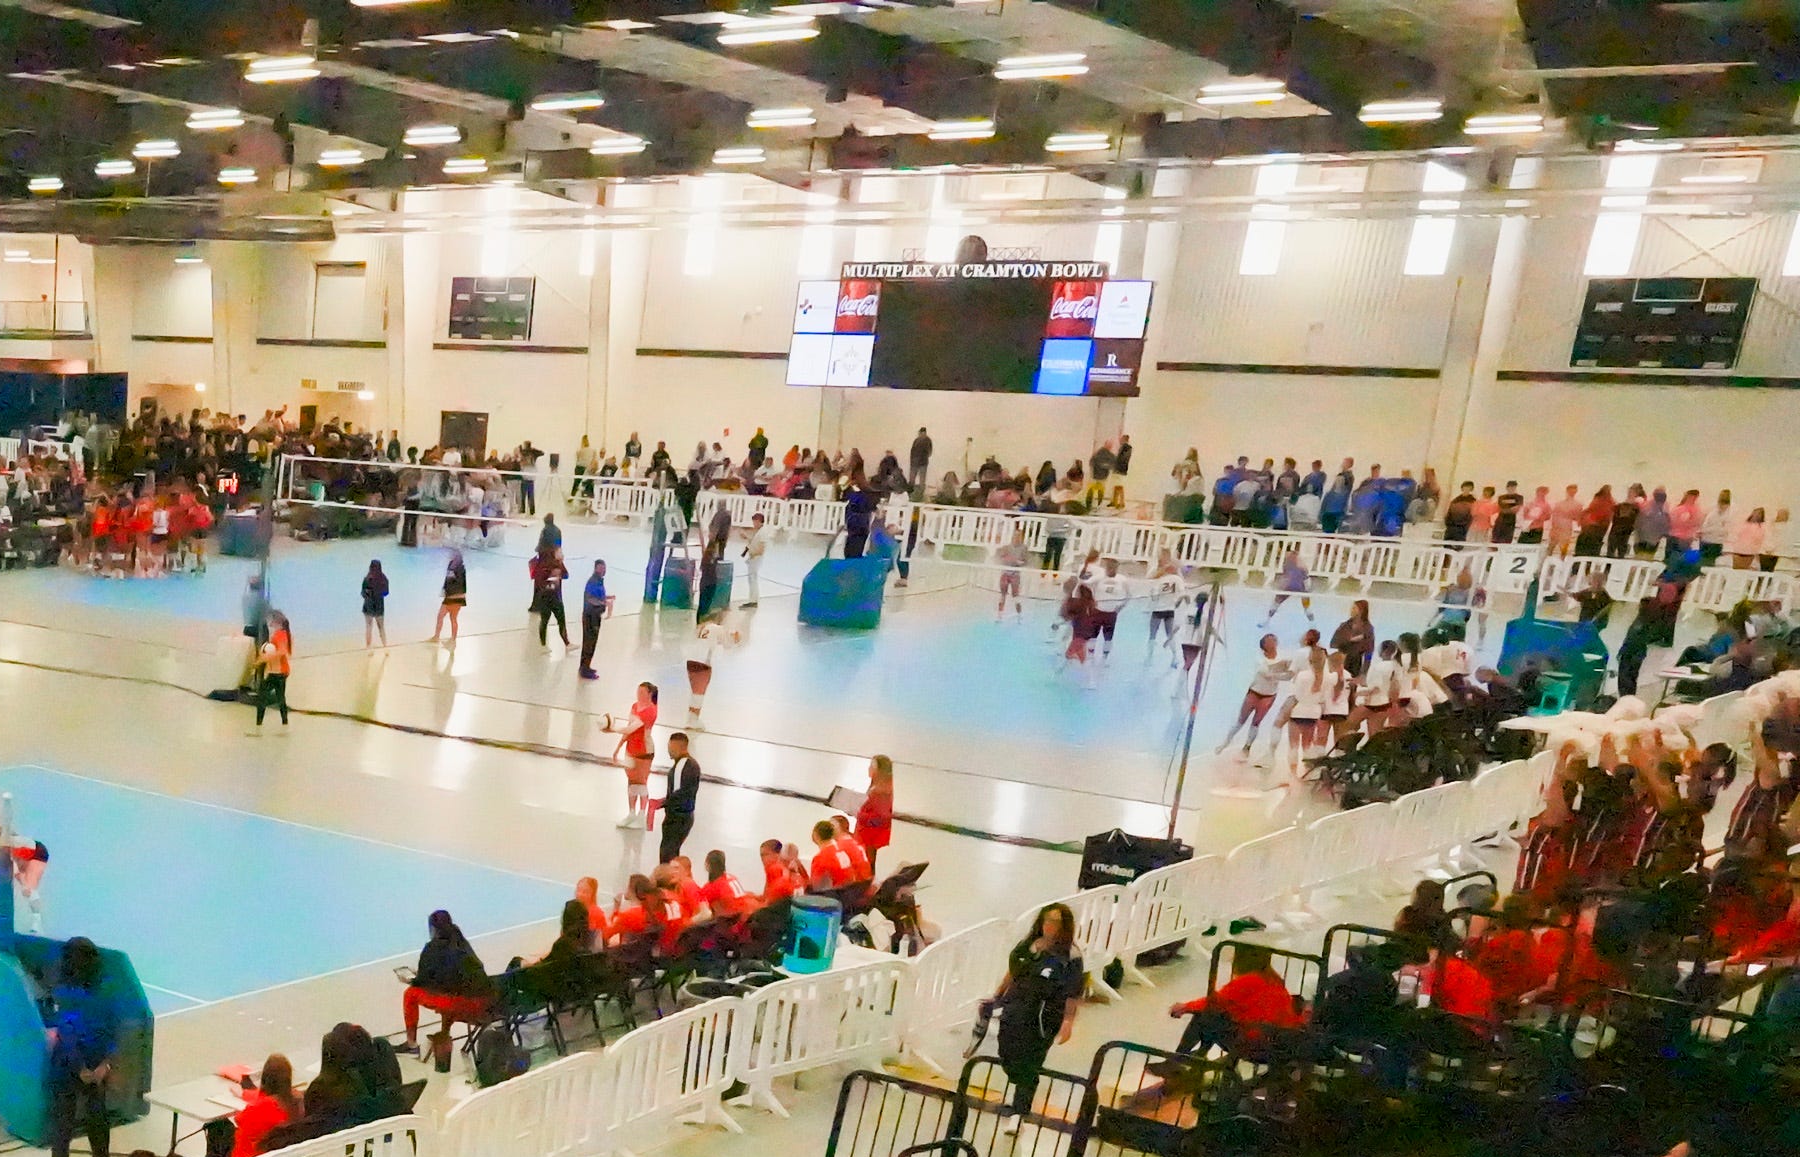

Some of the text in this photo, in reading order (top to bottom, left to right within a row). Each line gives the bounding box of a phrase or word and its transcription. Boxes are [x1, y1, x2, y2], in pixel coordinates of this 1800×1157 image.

[843, 264, 1103, 278] MULTIPLEX AT CRAMTON BOWL
[1509, 556, 1528, 574] 2
